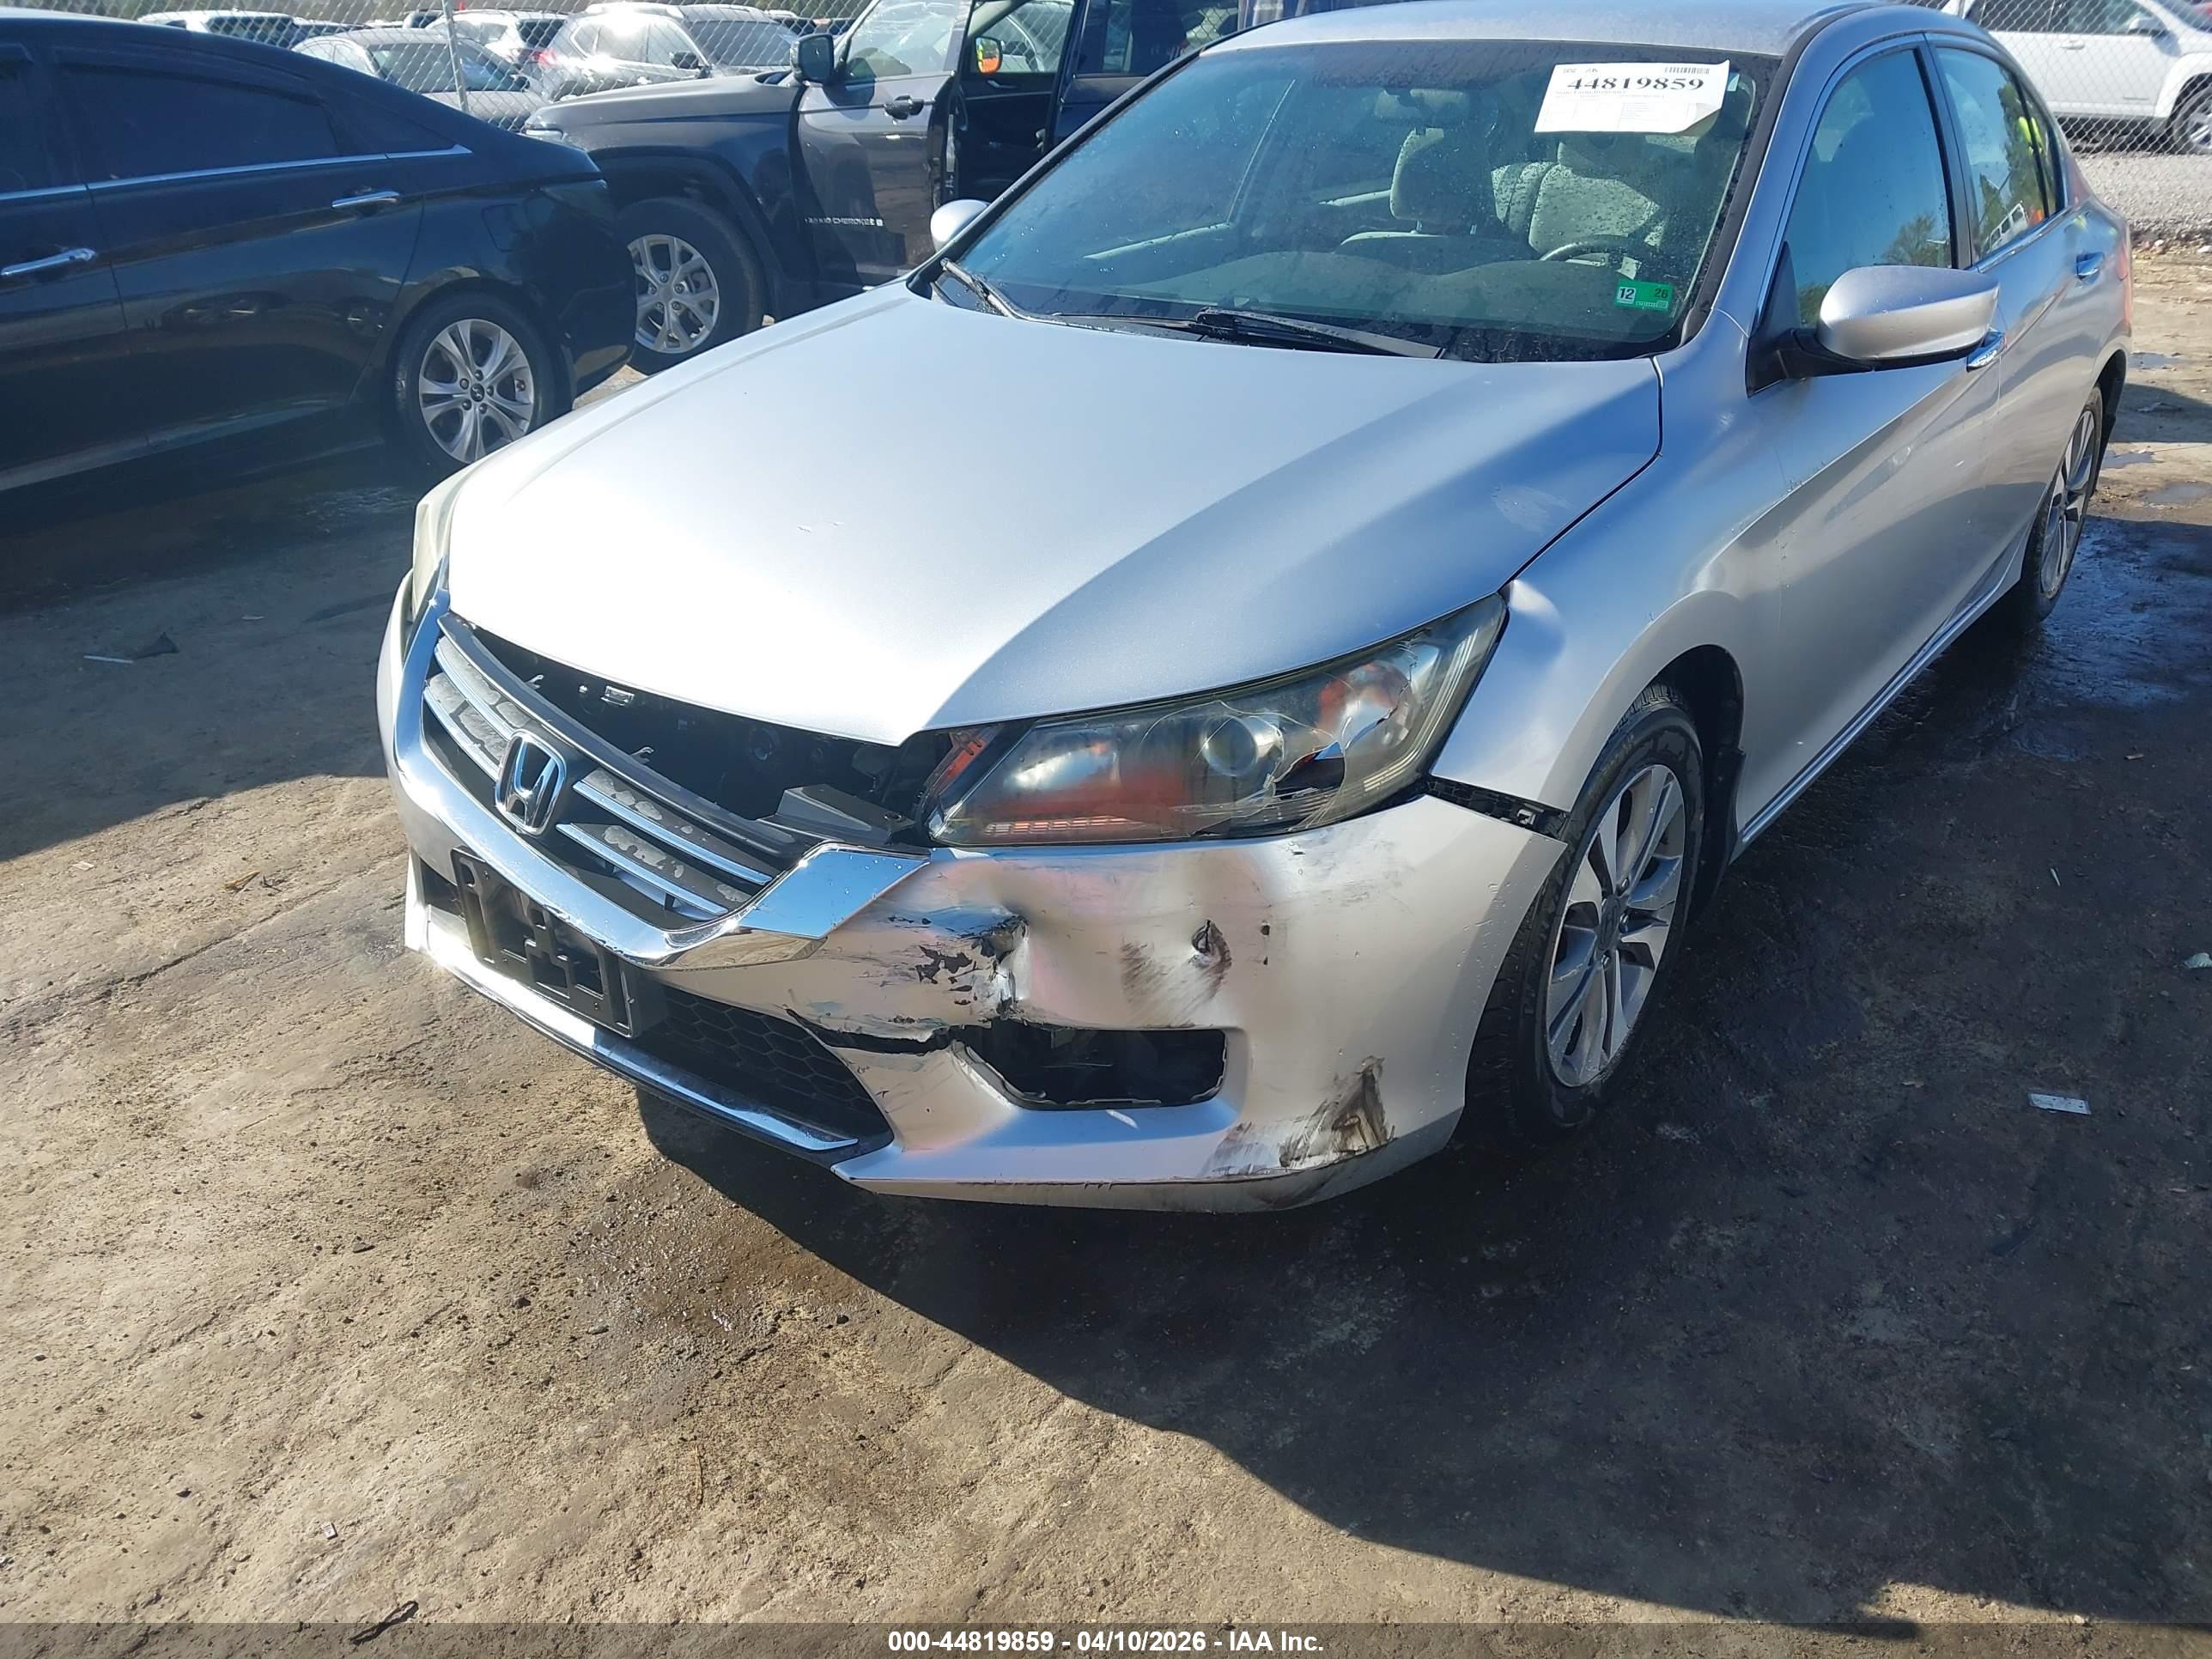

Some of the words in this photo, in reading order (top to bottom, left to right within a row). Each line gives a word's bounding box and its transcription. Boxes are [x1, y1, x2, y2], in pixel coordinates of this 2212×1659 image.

[1567, 76, 1705, 91] 44819859
[1620, 288, 1635, 300] 12
[1654, 288, 1668, 299] 26
